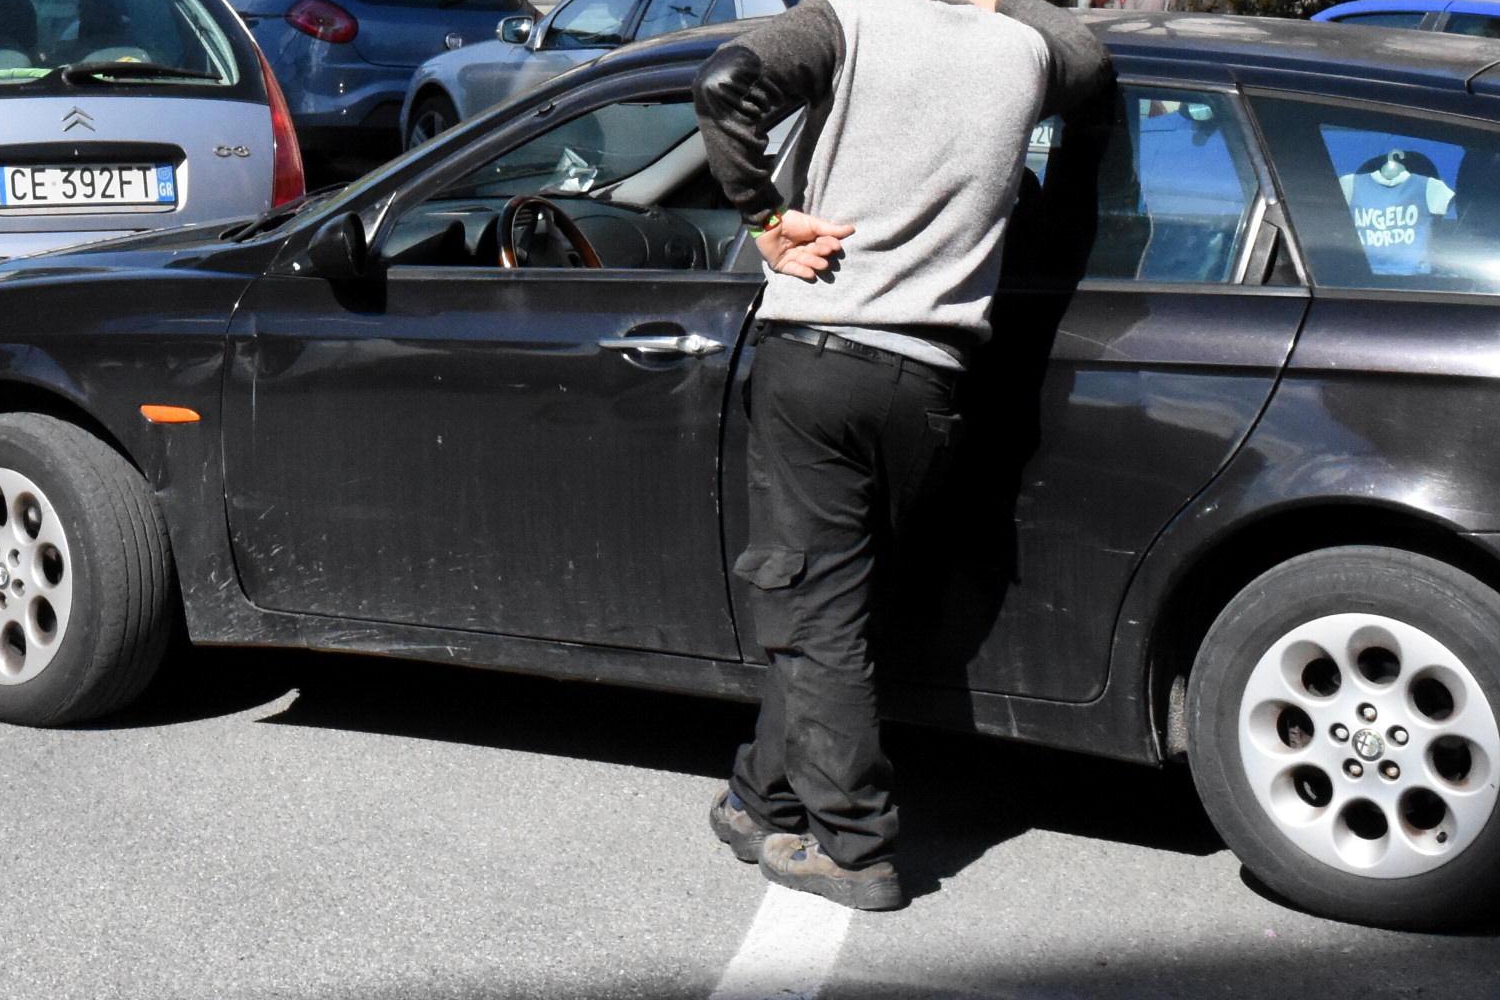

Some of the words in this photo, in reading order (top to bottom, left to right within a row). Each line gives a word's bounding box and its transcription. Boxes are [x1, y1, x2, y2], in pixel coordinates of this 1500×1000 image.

[11, 168, 48, 200] CE
[60, 166, 150, 199] 392FT
[159, 182, 173, 197] GR
[1355, 204, 1418, 230] ANGELO
[1366, 228, 1415, 247] BORDO
